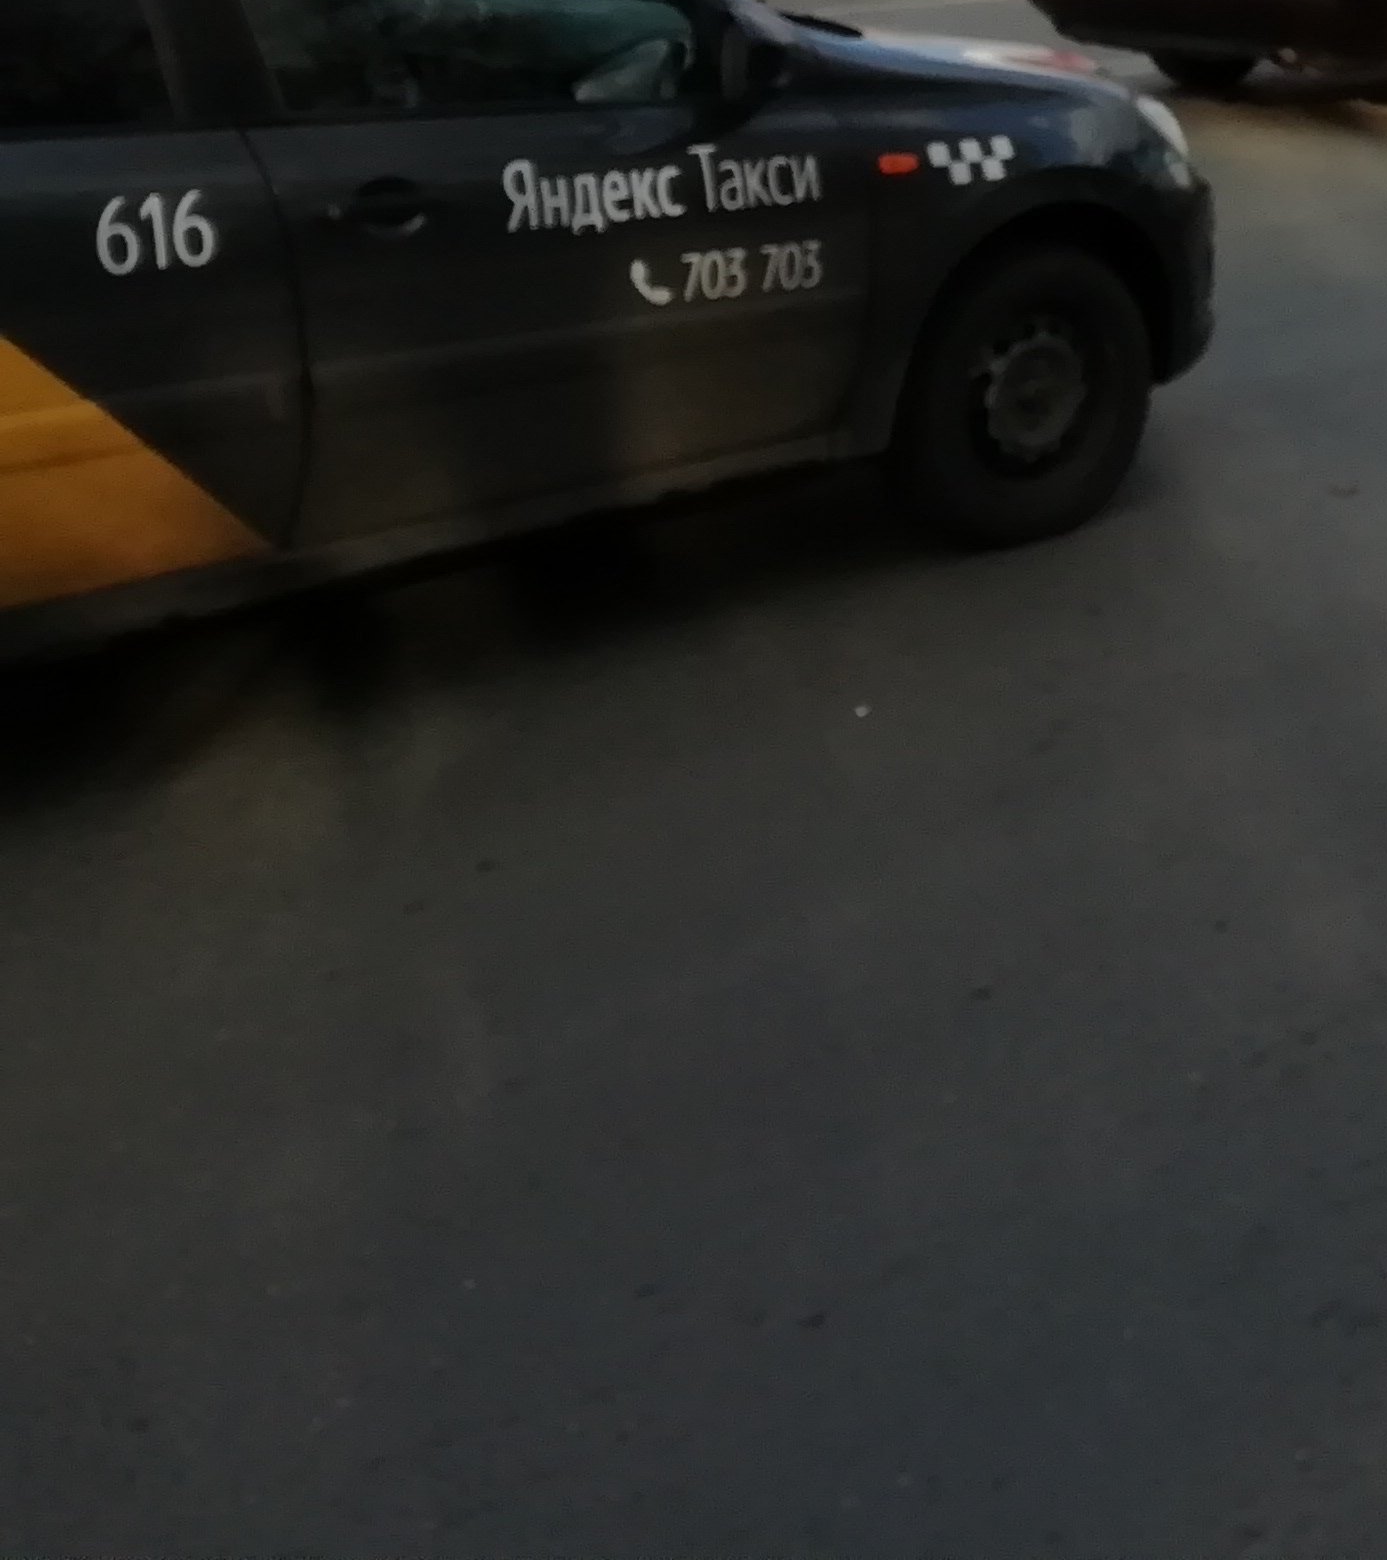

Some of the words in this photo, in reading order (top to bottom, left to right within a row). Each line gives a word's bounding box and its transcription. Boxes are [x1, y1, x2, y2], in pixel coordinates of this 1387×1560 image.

[96, 188, 215, 276] 616
[502, 158, 688, 236] Яндекс
[686, 142, 823, 213] Такси
[680, 246, 747, 303] 703
[760, 239, 823, 292] 703
